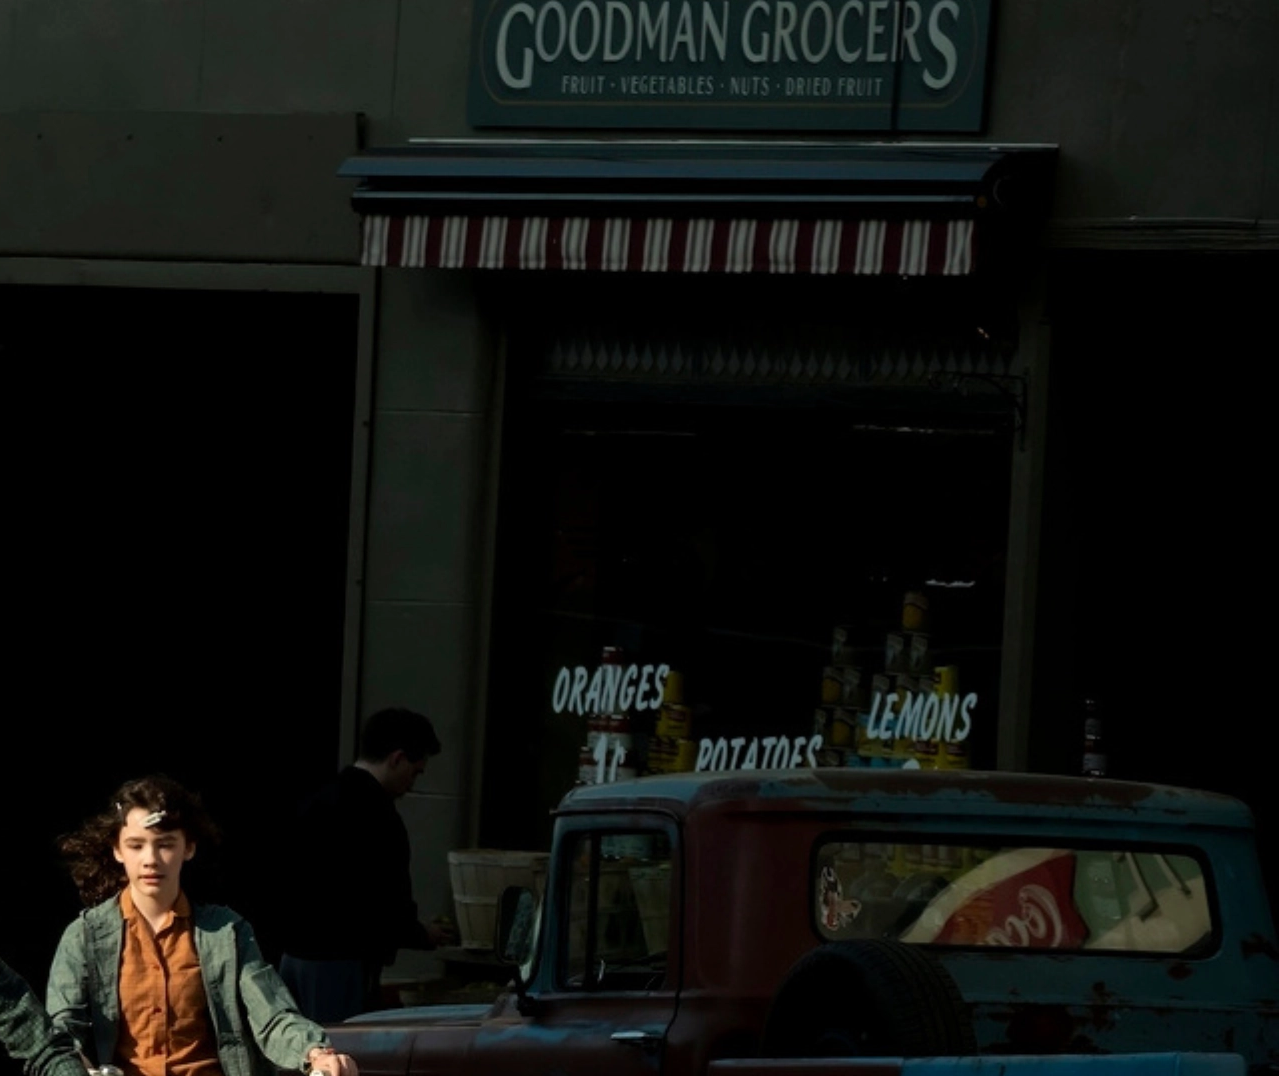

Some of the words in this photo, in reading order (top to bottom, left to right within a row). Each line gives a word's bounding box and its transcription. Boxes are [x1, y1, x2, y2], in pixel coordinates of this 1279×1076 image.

[495, 0, 729, 89] GOODMAN
[741, 0, 961, 90] GROCERS
[561, 74, 606, 95] FRUIT
[620, 75, 715, 95] VEGETABLES
[730, 76, 770, 96] NUTS
[785, 77, 832, 96] DRIED
[838, 77, 884, 96] FRUIT
[551, 663, 671, 717] ORANGES
[866, 690, 979, 743] LEMONS
[694, 733, 826, 771] POTATOES
